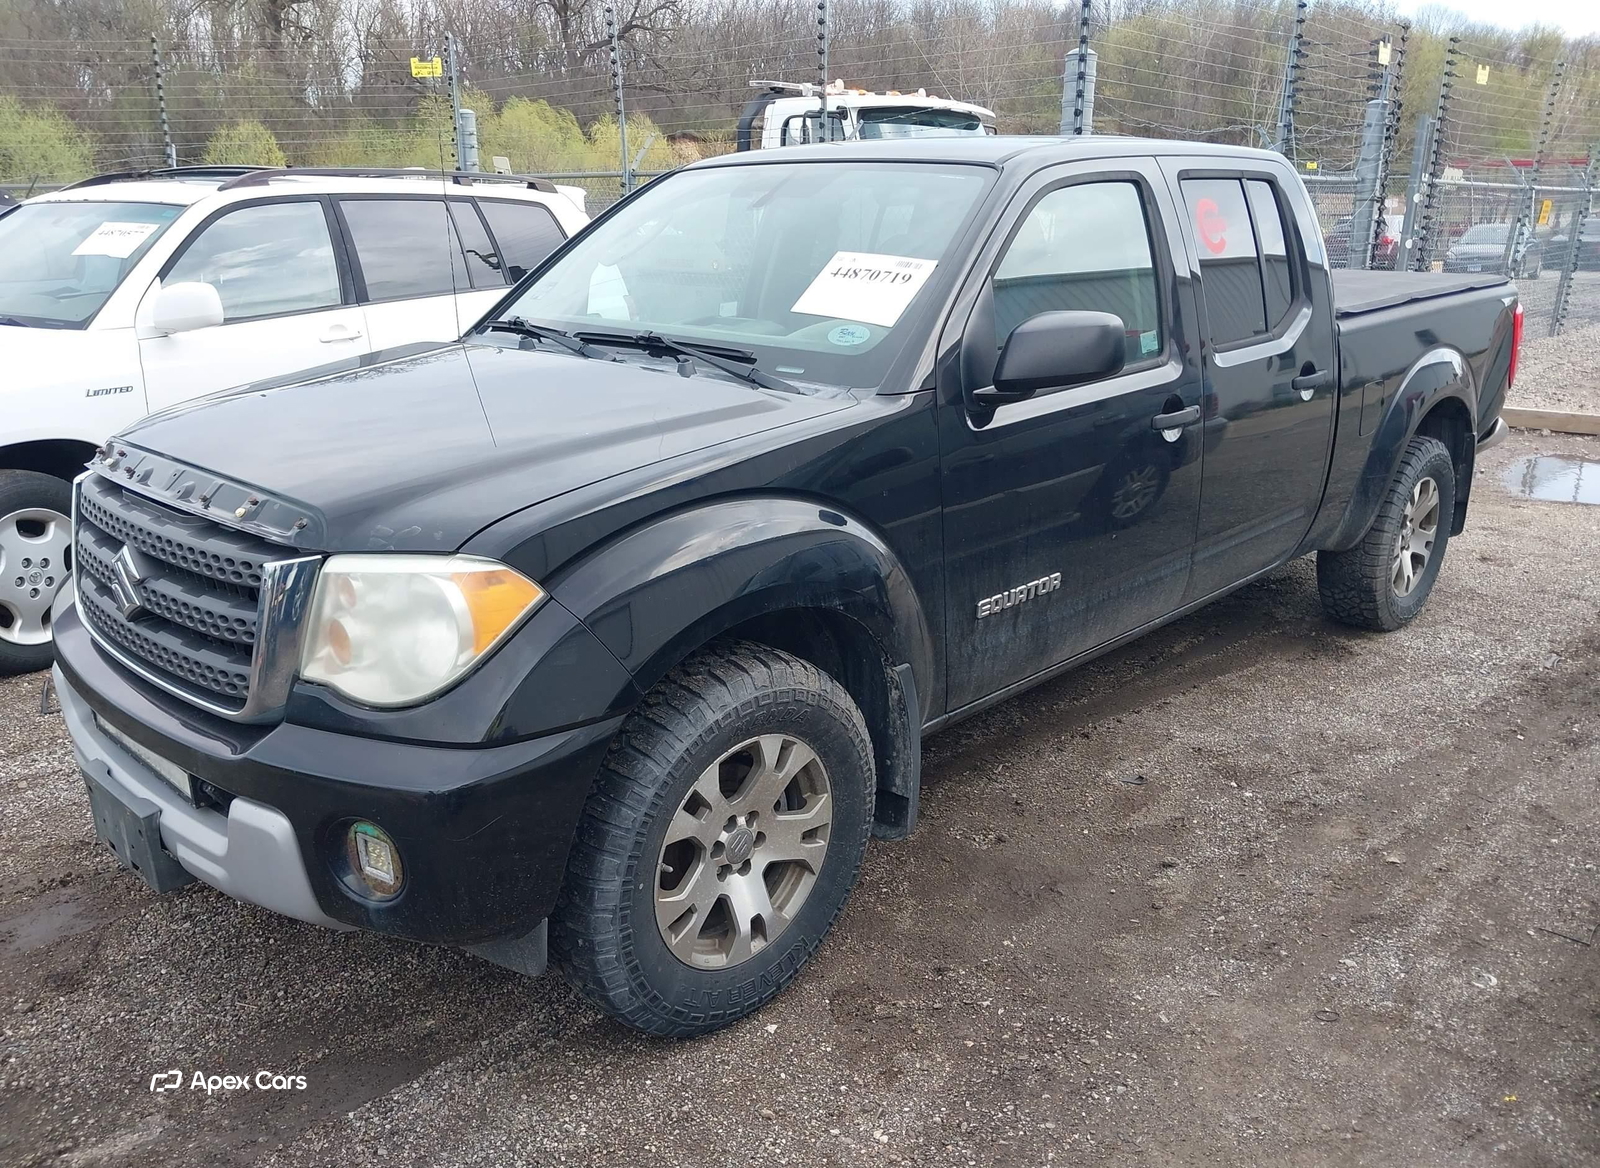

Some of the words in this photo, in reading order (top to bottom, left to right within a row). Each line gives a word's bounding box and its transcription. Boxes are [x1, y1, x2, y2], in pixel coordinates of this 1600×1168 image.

[830, 267, 912, 284] 44870719
[976, 572, 1062, 619] EQUATOR
[726, 935, 810, 1005] KLEVER
